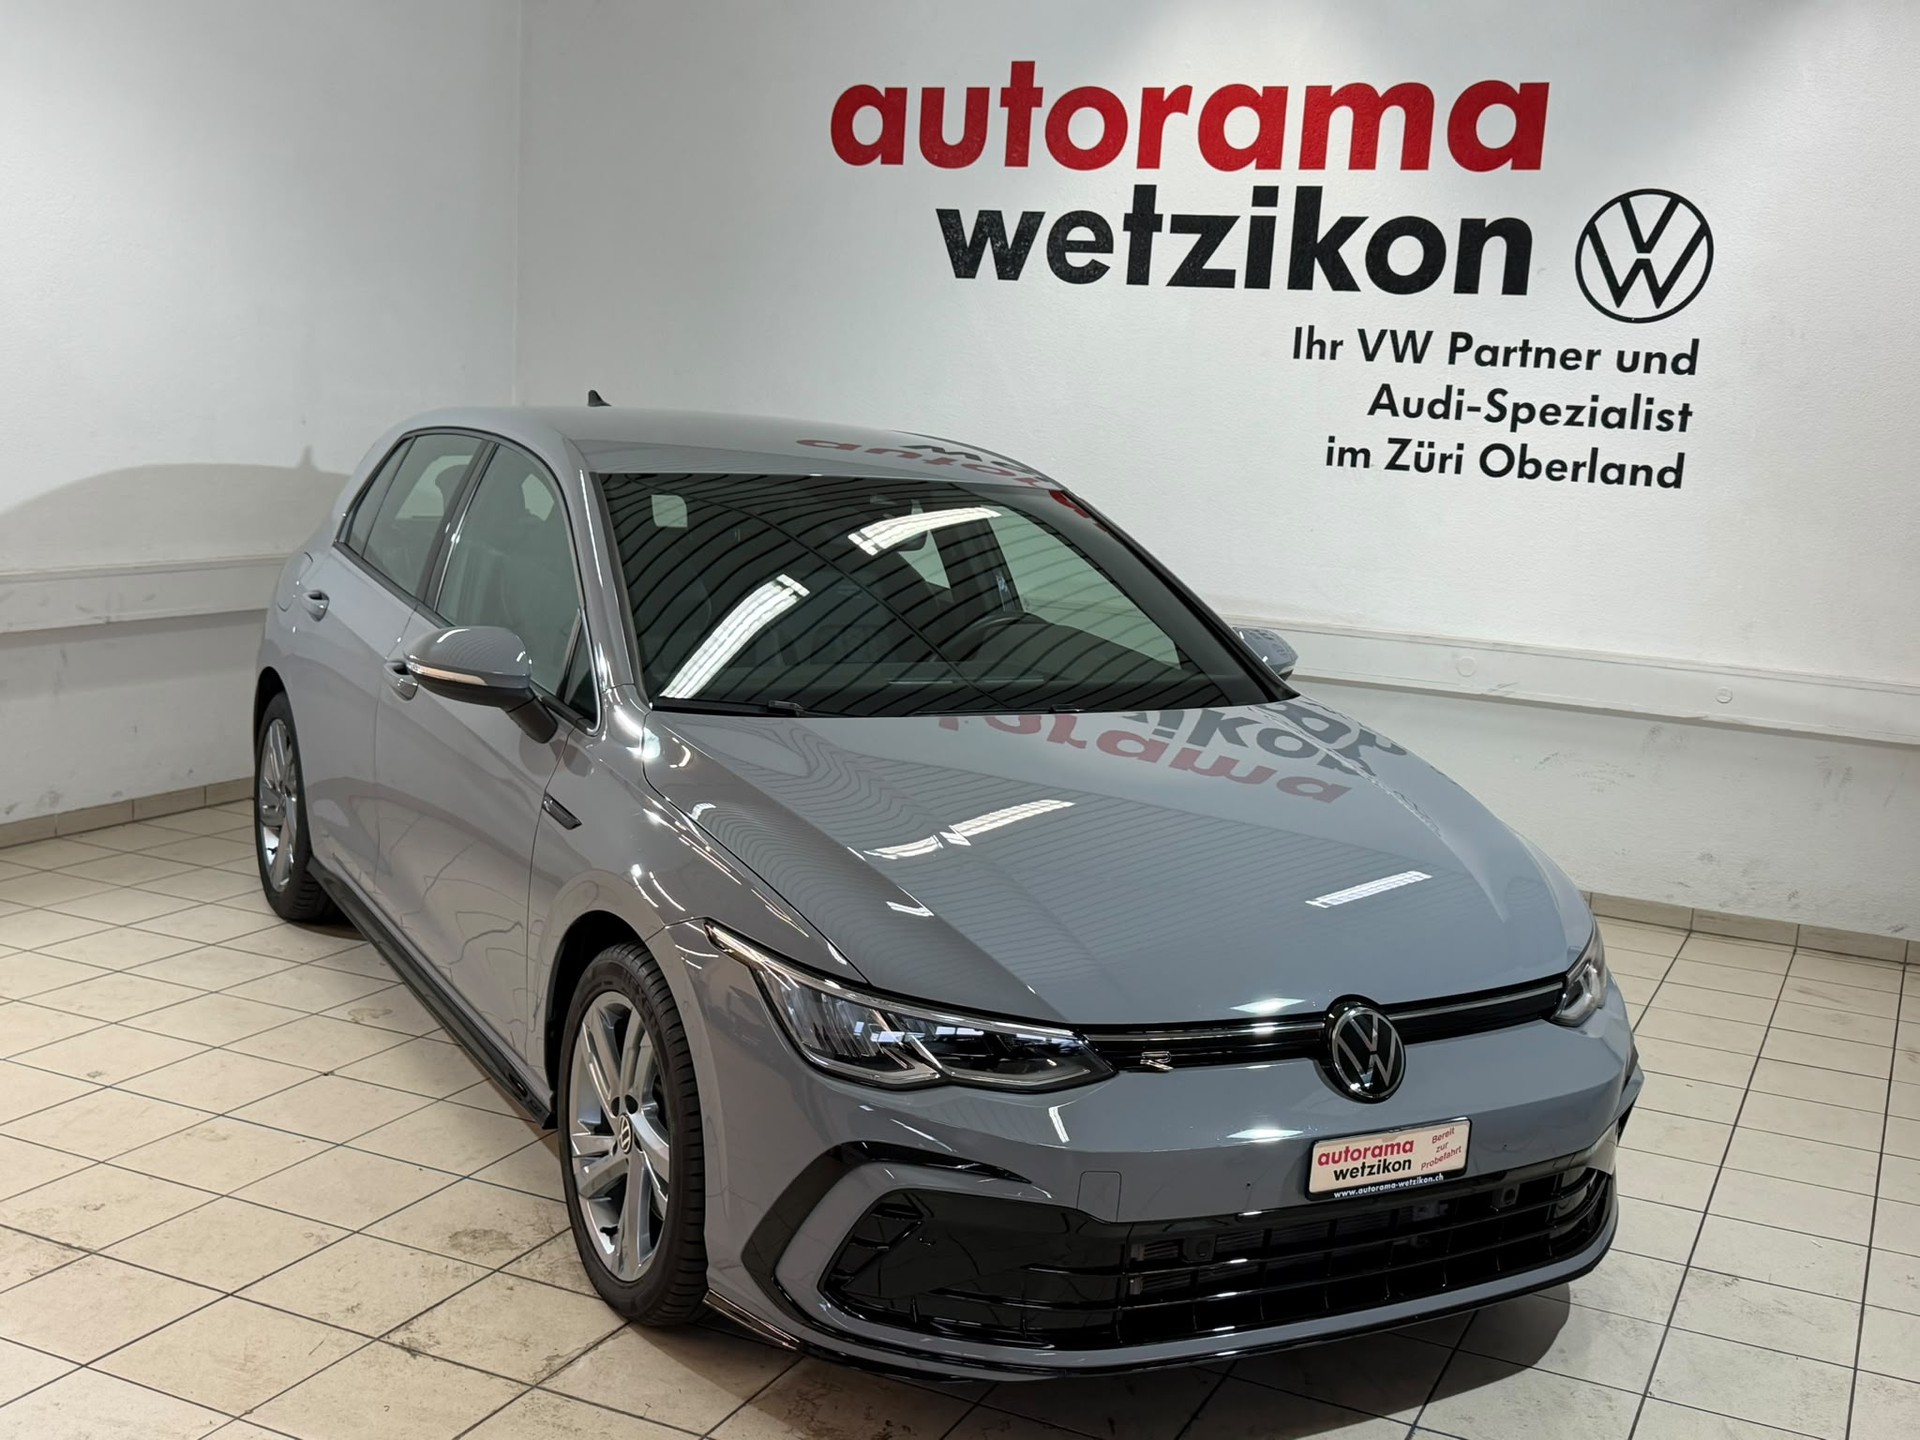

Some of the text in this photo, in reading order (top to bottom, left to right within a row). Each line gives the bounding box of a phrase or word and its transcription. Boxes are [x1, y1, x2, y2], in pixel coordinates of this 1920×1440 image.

[830, 60, 1550, 173] autorama
[935, 184, 1534, 296] wetzikon
[1292, 324, 1700, 376] Ihr VW Partner und
[1367, 383, 1694, 434] Audi-Spezialist
[1325, 435, 1687, 490] im Züri Oberland
[1431, 1127, 1455, 1144] Bereit
[1436, 1141, 1449, 1153] zur
[1317, 1139, 1415, 1167] autorama
[1421, 1145, 1462, 1171] Probefahrt
[1333, 1158, 1412, 1182] wetzikon
[1333, 1172, 1444, 1199] www.autorama-wetzikon.ch
